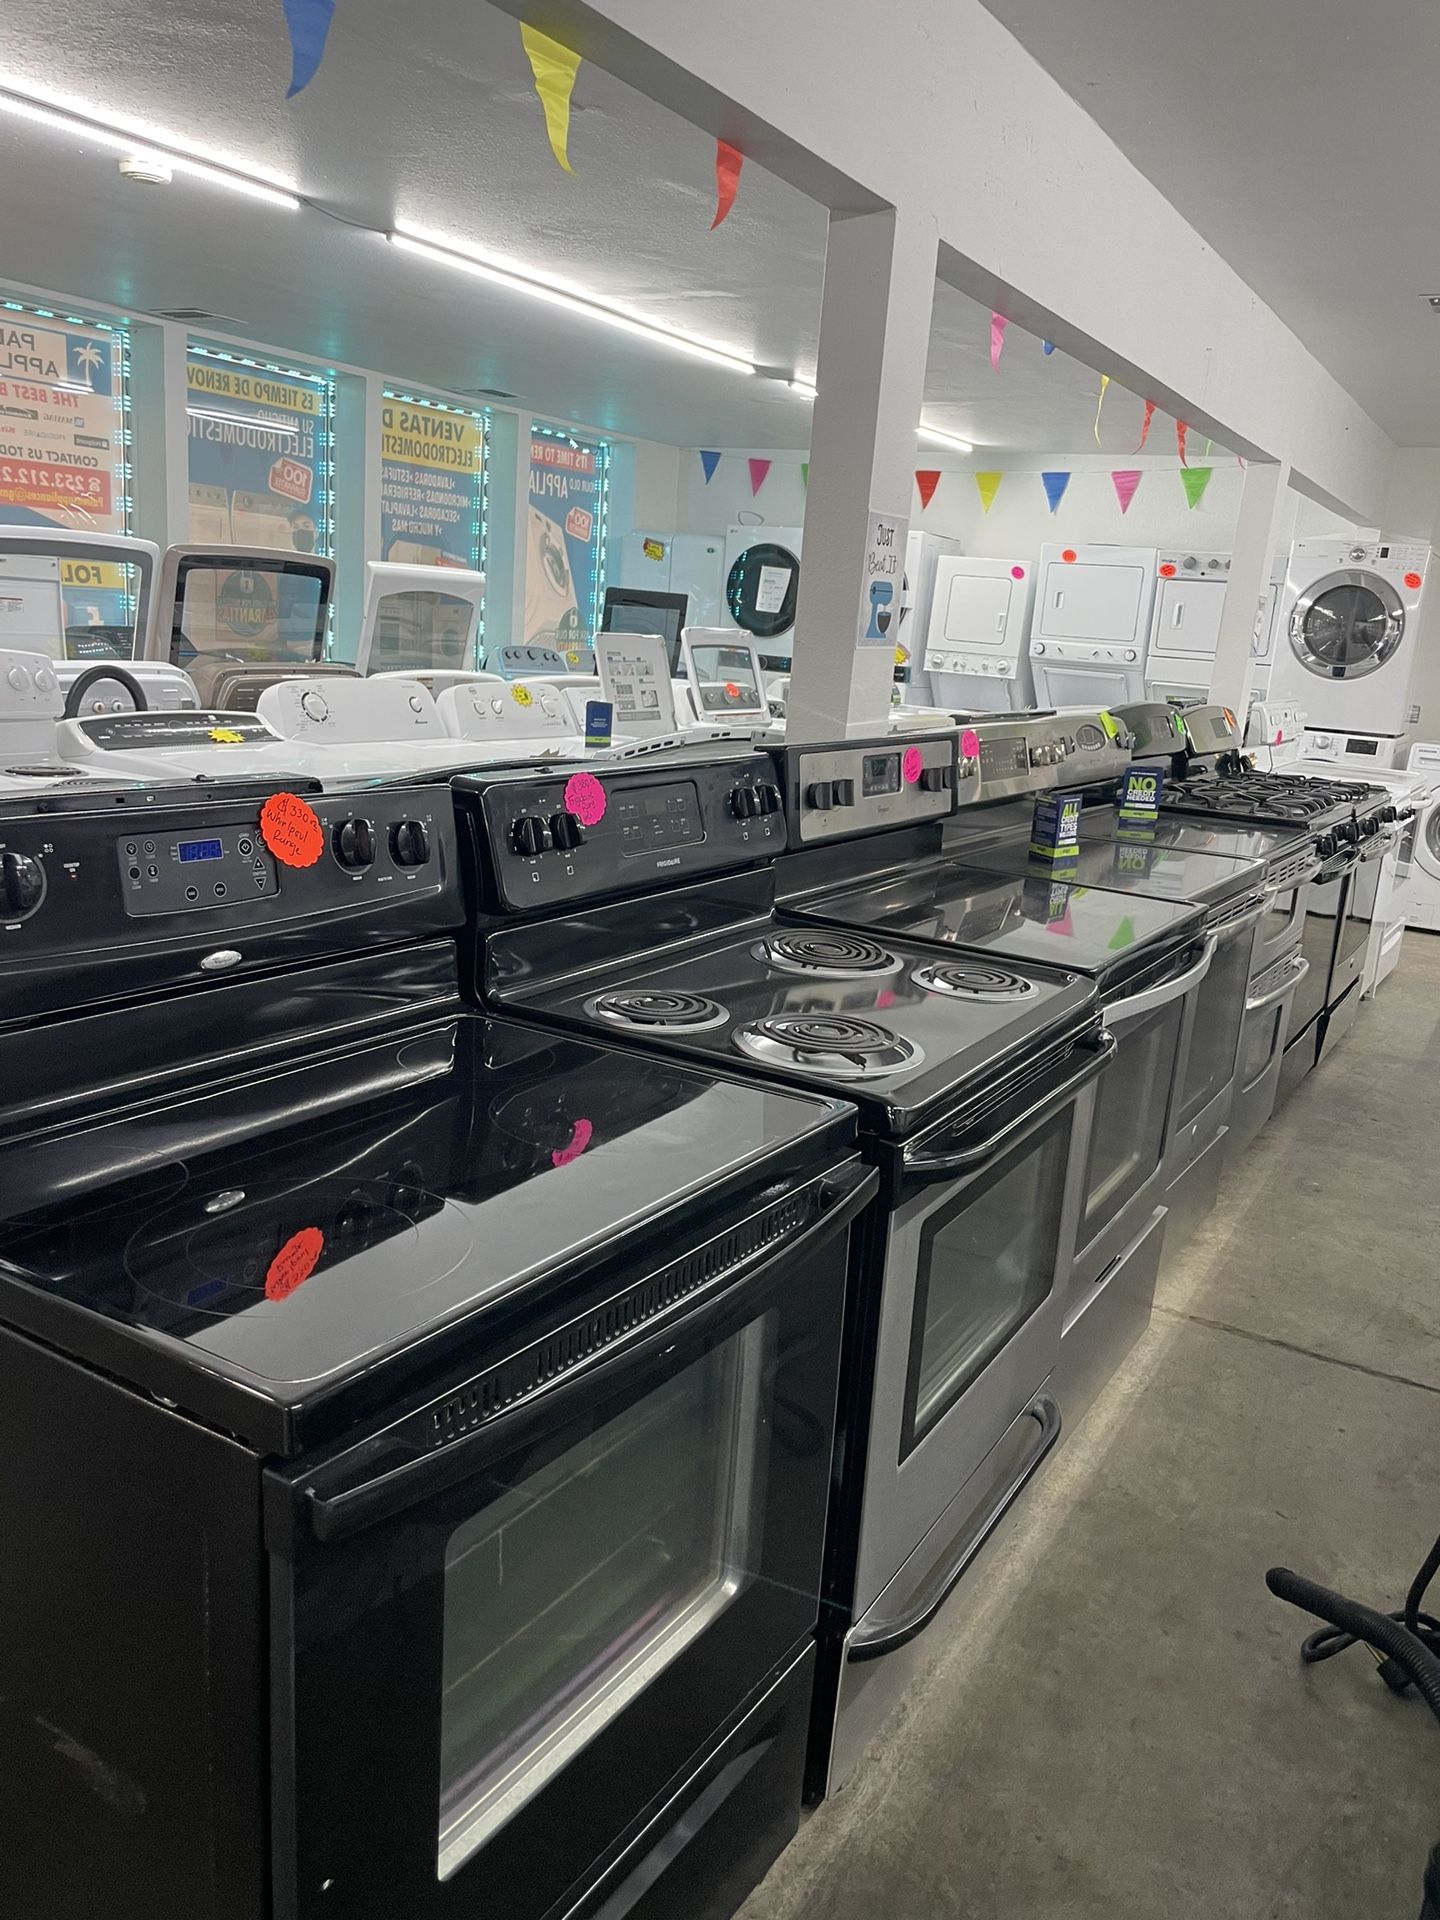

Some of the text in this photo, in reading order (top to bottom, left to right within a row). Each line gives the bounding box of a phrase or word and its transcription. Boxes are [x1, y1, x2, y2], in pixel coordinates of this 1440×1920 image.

[876, 524, 894, 546] JUST
[1128, 776, 1157, 791] NO
[1126, 794, 1155, 802] NEEDED
[1127, 788, 1156, 799] CREDIT
[1062, 802, 1079, 817] ALL
[1060, 813, 1079, 824] CREDIT
[1060, 822, 1078, 834] TYPES
